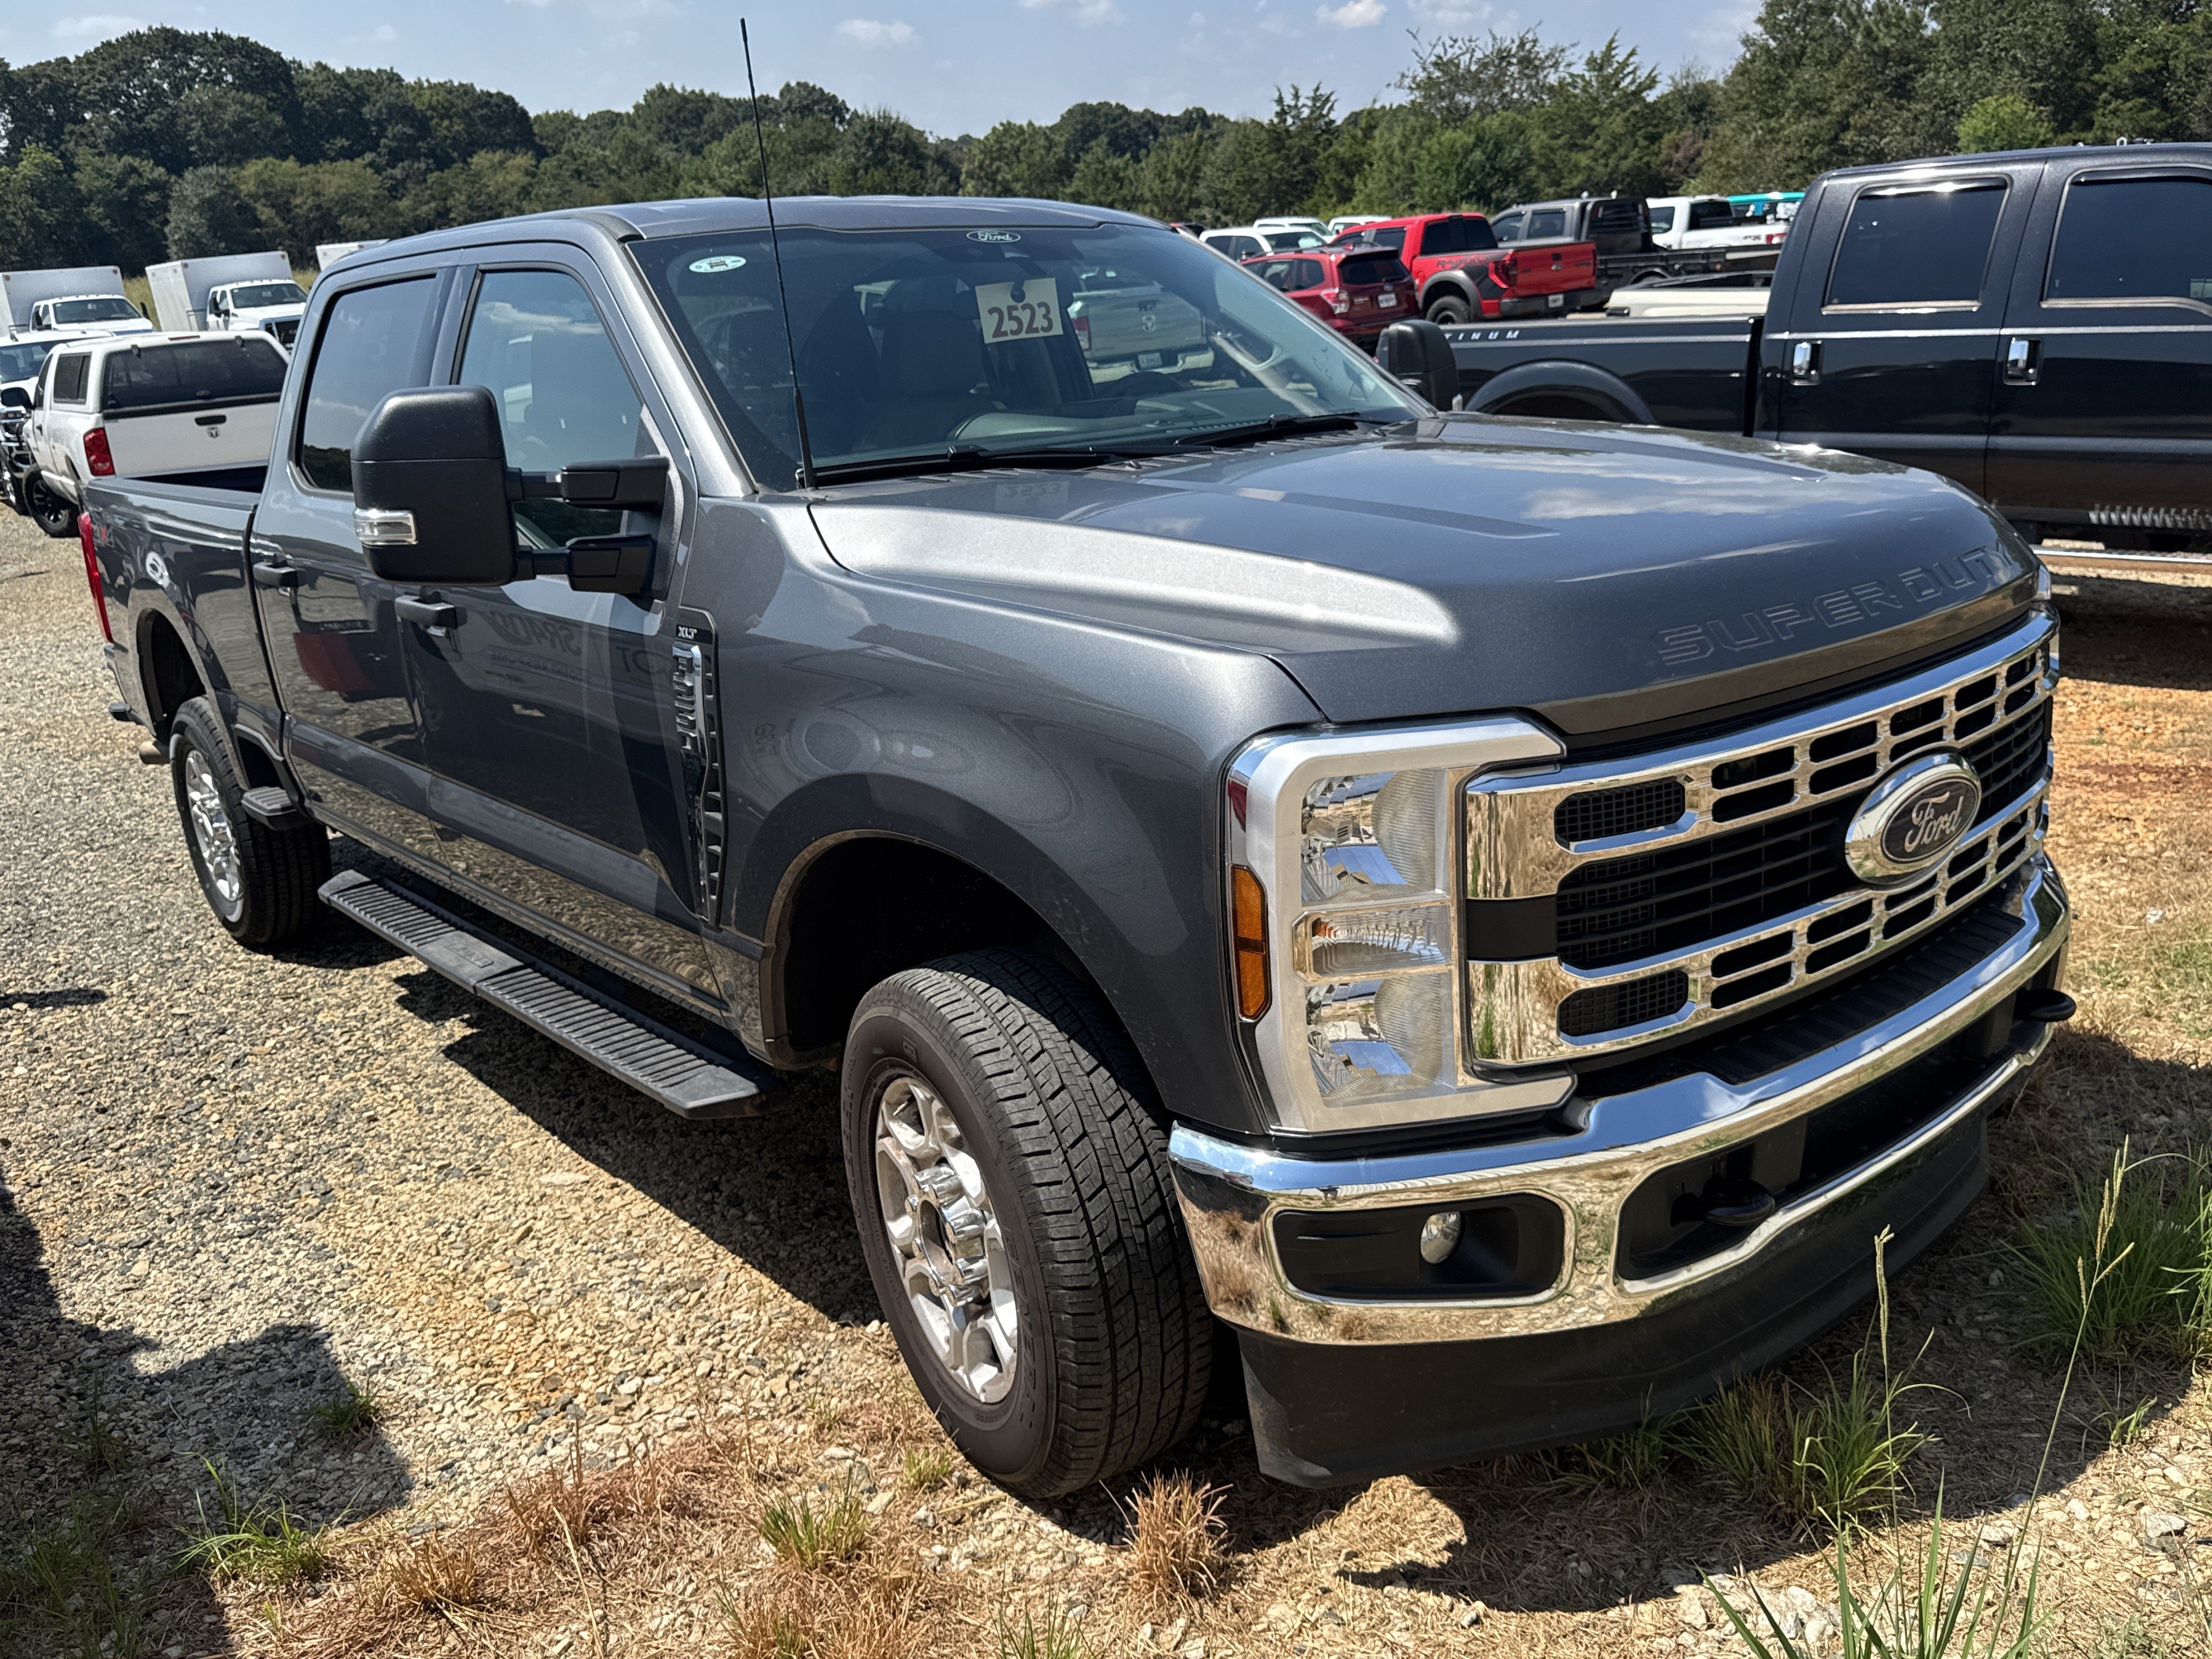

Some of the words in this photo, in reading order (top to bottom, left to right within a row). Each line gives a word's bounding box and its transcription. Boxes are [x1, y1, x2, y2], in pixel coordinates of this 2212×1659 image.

[977, 230, 1013, 241] Ford
[987, 301, 1054, 339] 2523
[1443, 329, 1520, 341] TINUM
[1650, 579, 1904, 666] SUPER
[1898, 538, 2015, 603] DUTY
[677, 625, 697, 640] XLT
[1904, 791, 1963, 853] Ford
